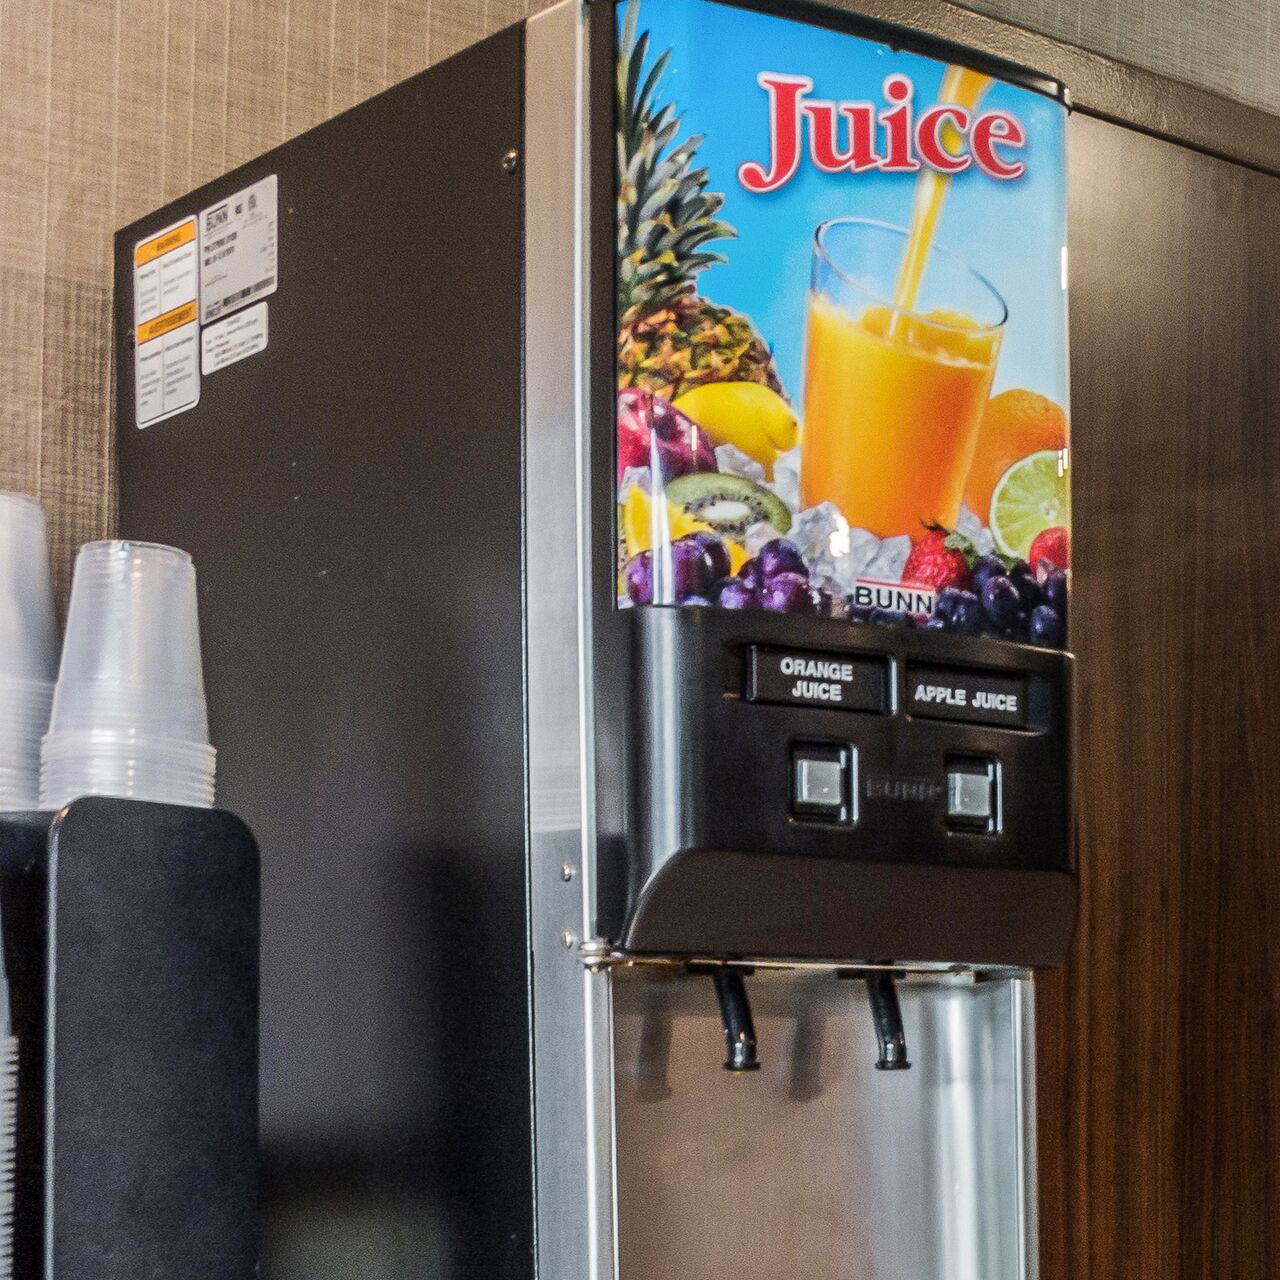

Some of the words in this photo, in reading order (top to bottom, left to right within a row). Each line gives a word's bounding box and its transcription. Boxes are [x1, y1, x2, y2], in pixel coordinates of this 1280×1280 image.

[738, 72, 1026, 193] Juice
[856, 586, 932, 614] BUNN
[780, 657, 853, 681] ORANGE
[792, 680, 842, 701] JUICE
[915, 685, 967, 706] APPLE
[972, 692, 1017, 711] JUICE
